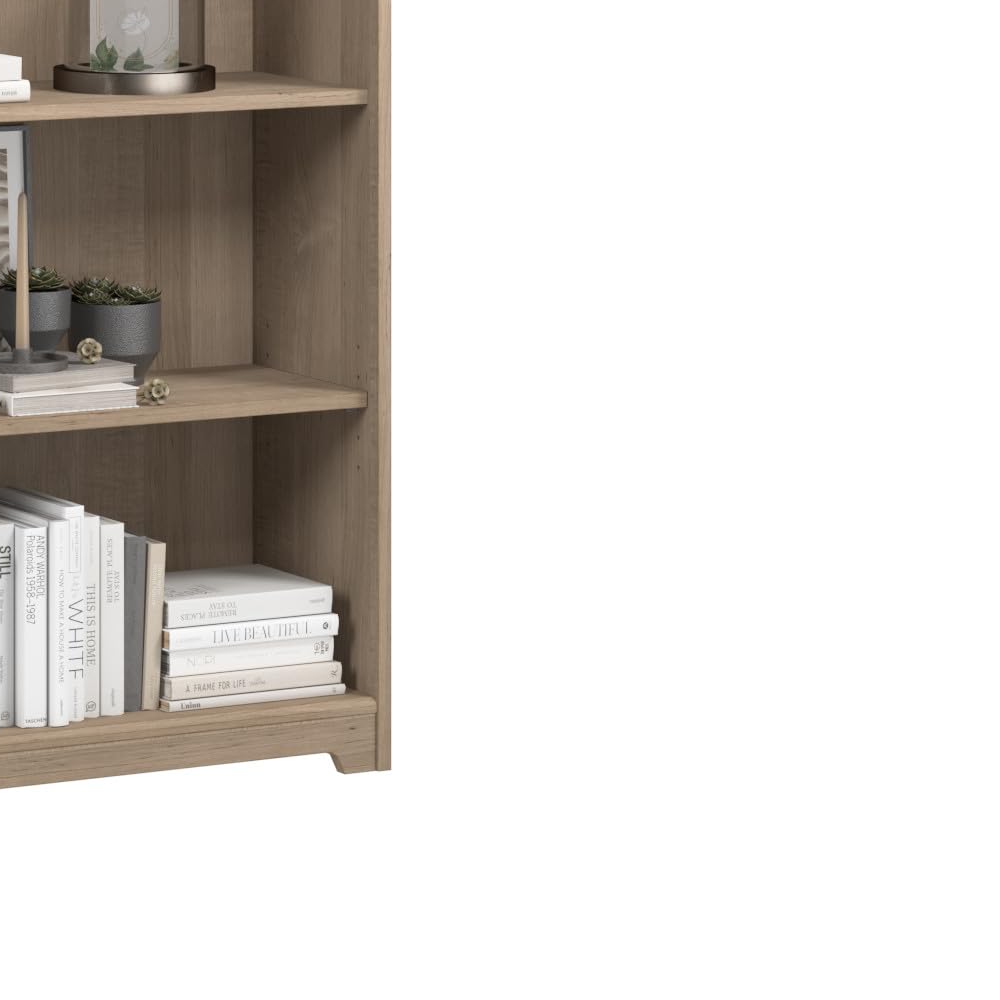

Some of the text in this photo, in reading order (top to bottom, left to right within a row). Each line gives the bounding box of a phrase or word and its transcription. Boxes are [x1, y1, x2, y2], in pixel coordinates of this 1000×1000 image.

[0, 545, 11, 579] STILL
[25, 535, 36, 575] Polaroids
[36, 535, 47, 599] ANDY WARHOL
[86, 583, 96, 667] THIS IS HOME
[212, 626, 241, 644] LIVE
[193, 682, 216, 692] FRAME
[218, 681, 231, 689] FOR
[233, 679, 246, 688] LIFE
